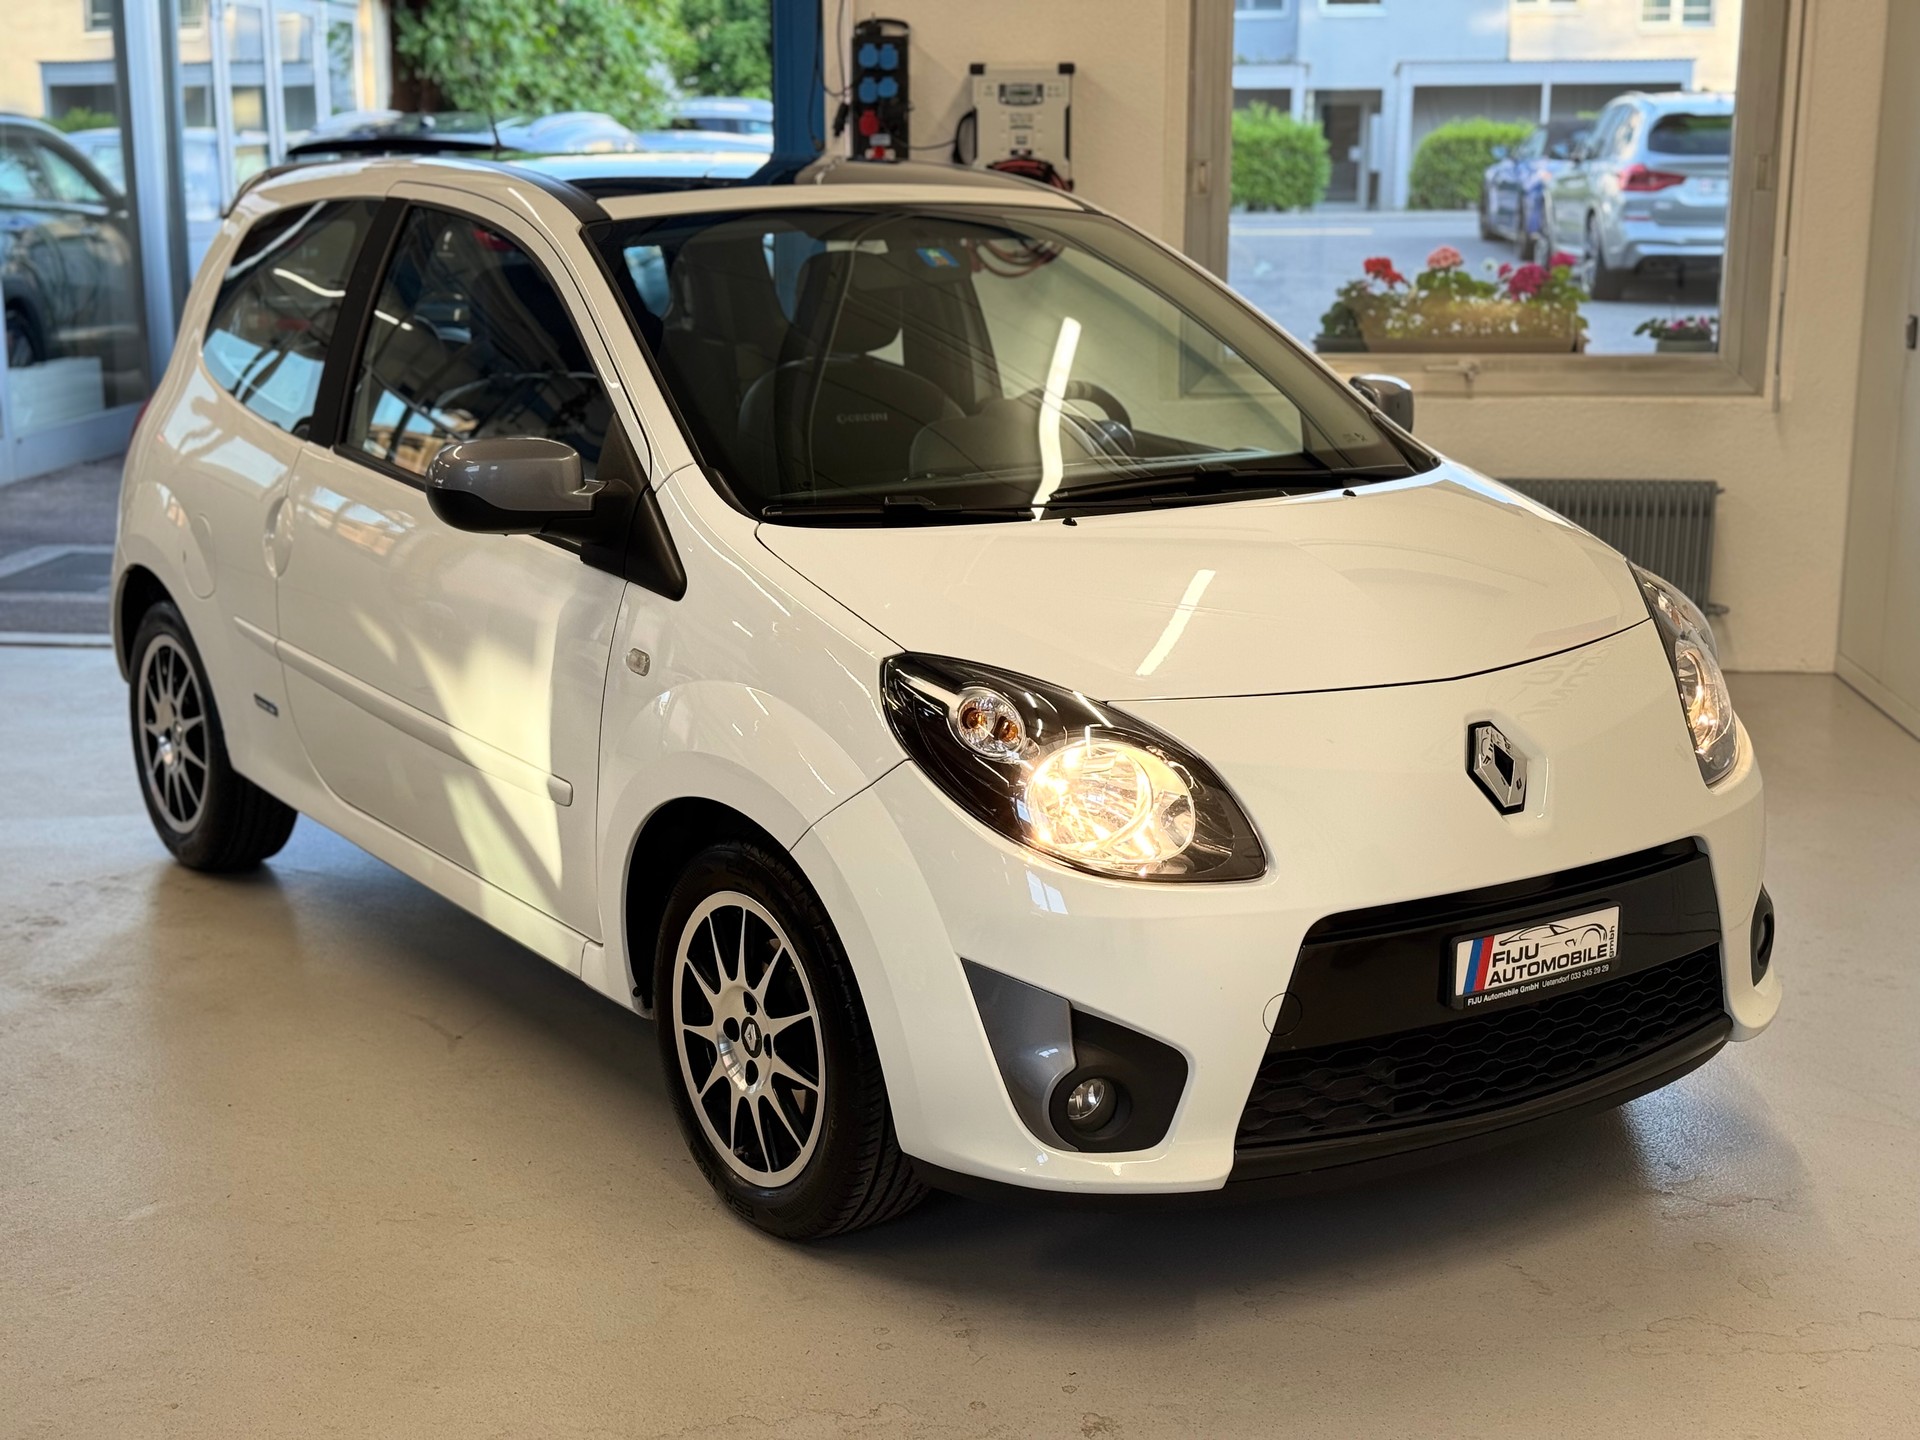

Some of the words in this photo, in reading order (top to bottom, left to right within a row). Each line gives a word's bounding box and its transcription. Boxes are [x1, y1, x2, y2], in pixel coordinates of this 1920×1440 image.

[1488, 943, 1608, 986] AUTOMOBILE
[1492, 943, 1539, 968] FIJU
[1467, 995, 1483, 1006] FIJU
[1483, 987, 1519, 1002] Automobile
[1520, 982, 1540, 993] GmbH
[1570, 971, 1582, 981] 033
